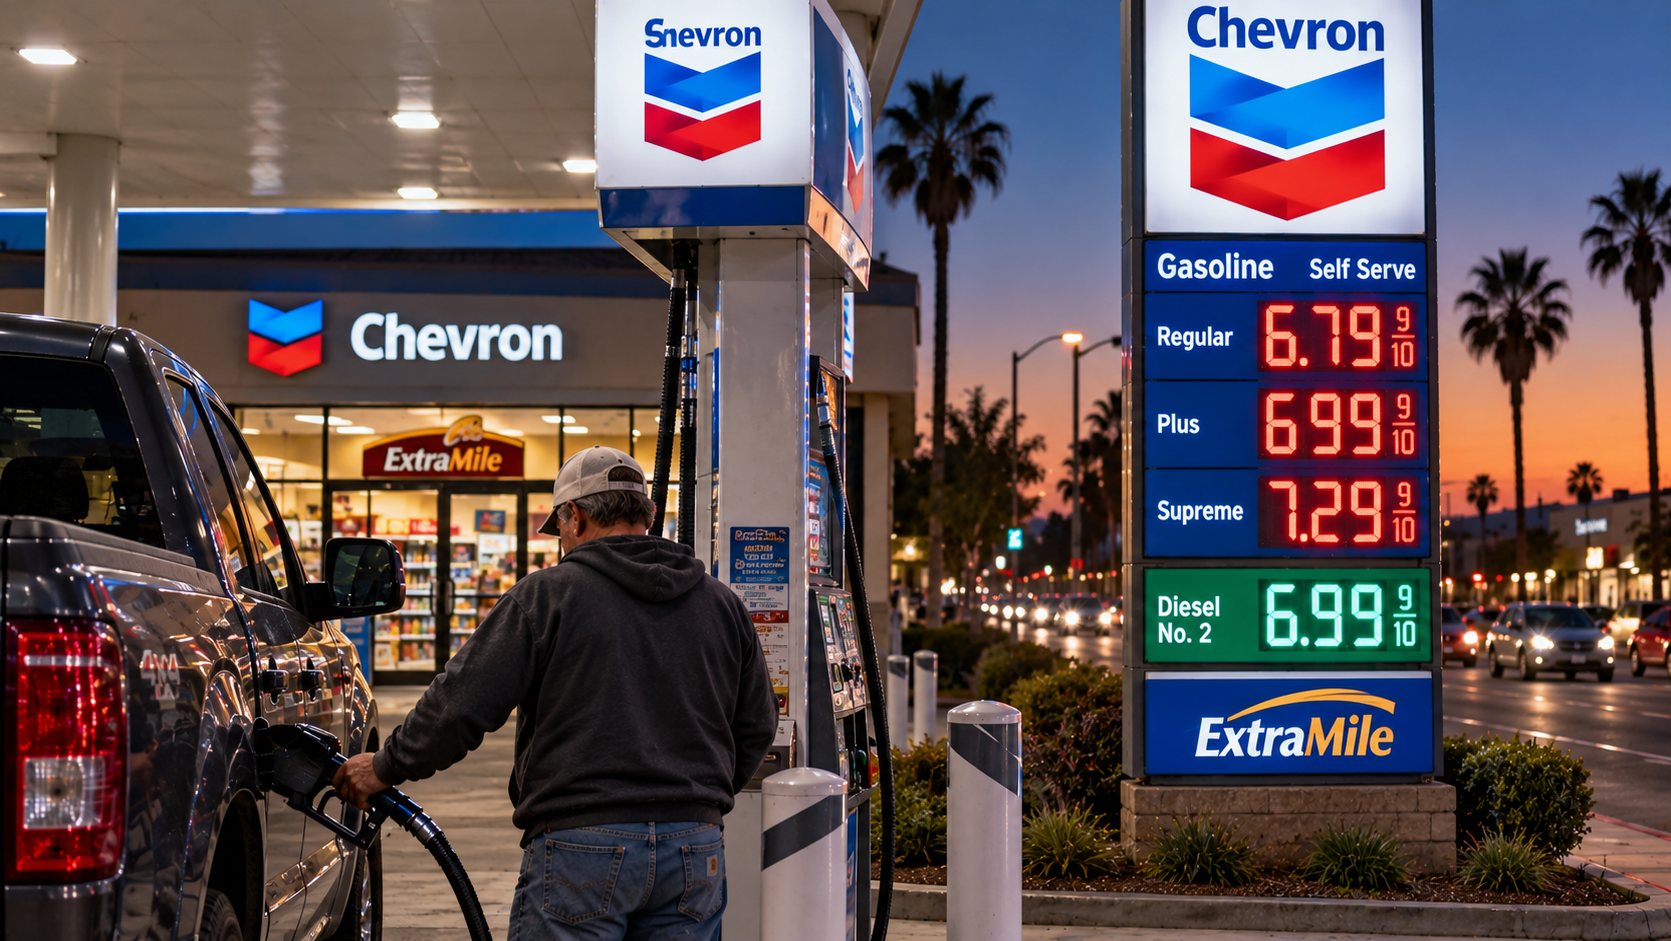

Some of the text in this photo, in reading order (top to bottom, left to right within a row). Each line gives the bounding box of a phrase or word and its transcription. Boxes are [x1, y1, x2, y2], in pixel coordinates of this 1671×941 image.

[1187, 5, 1385, 52] Chevron
[1157, 252, 1416, 281] Gasoline Self Serve
[350, 311, 563, 362] Chevron
[1157, 326, 1234, 350] Regular
[1264, 304, 1381, 368] 6.79
[1157, 413, 1200, 434] Plus
[383, 446, 504, 473] ExtraMile
[1157, 499, 1244, 526] Supreme
[1267, 480, 1383, 543] 7.29
[1158, 594, 1221, 618] Diesel
[1265, 583, 1383, 648] 6.99
[1158, 622, 1212, 645] No. 2
[1195, 713, 1395, 759] ExtraMile
